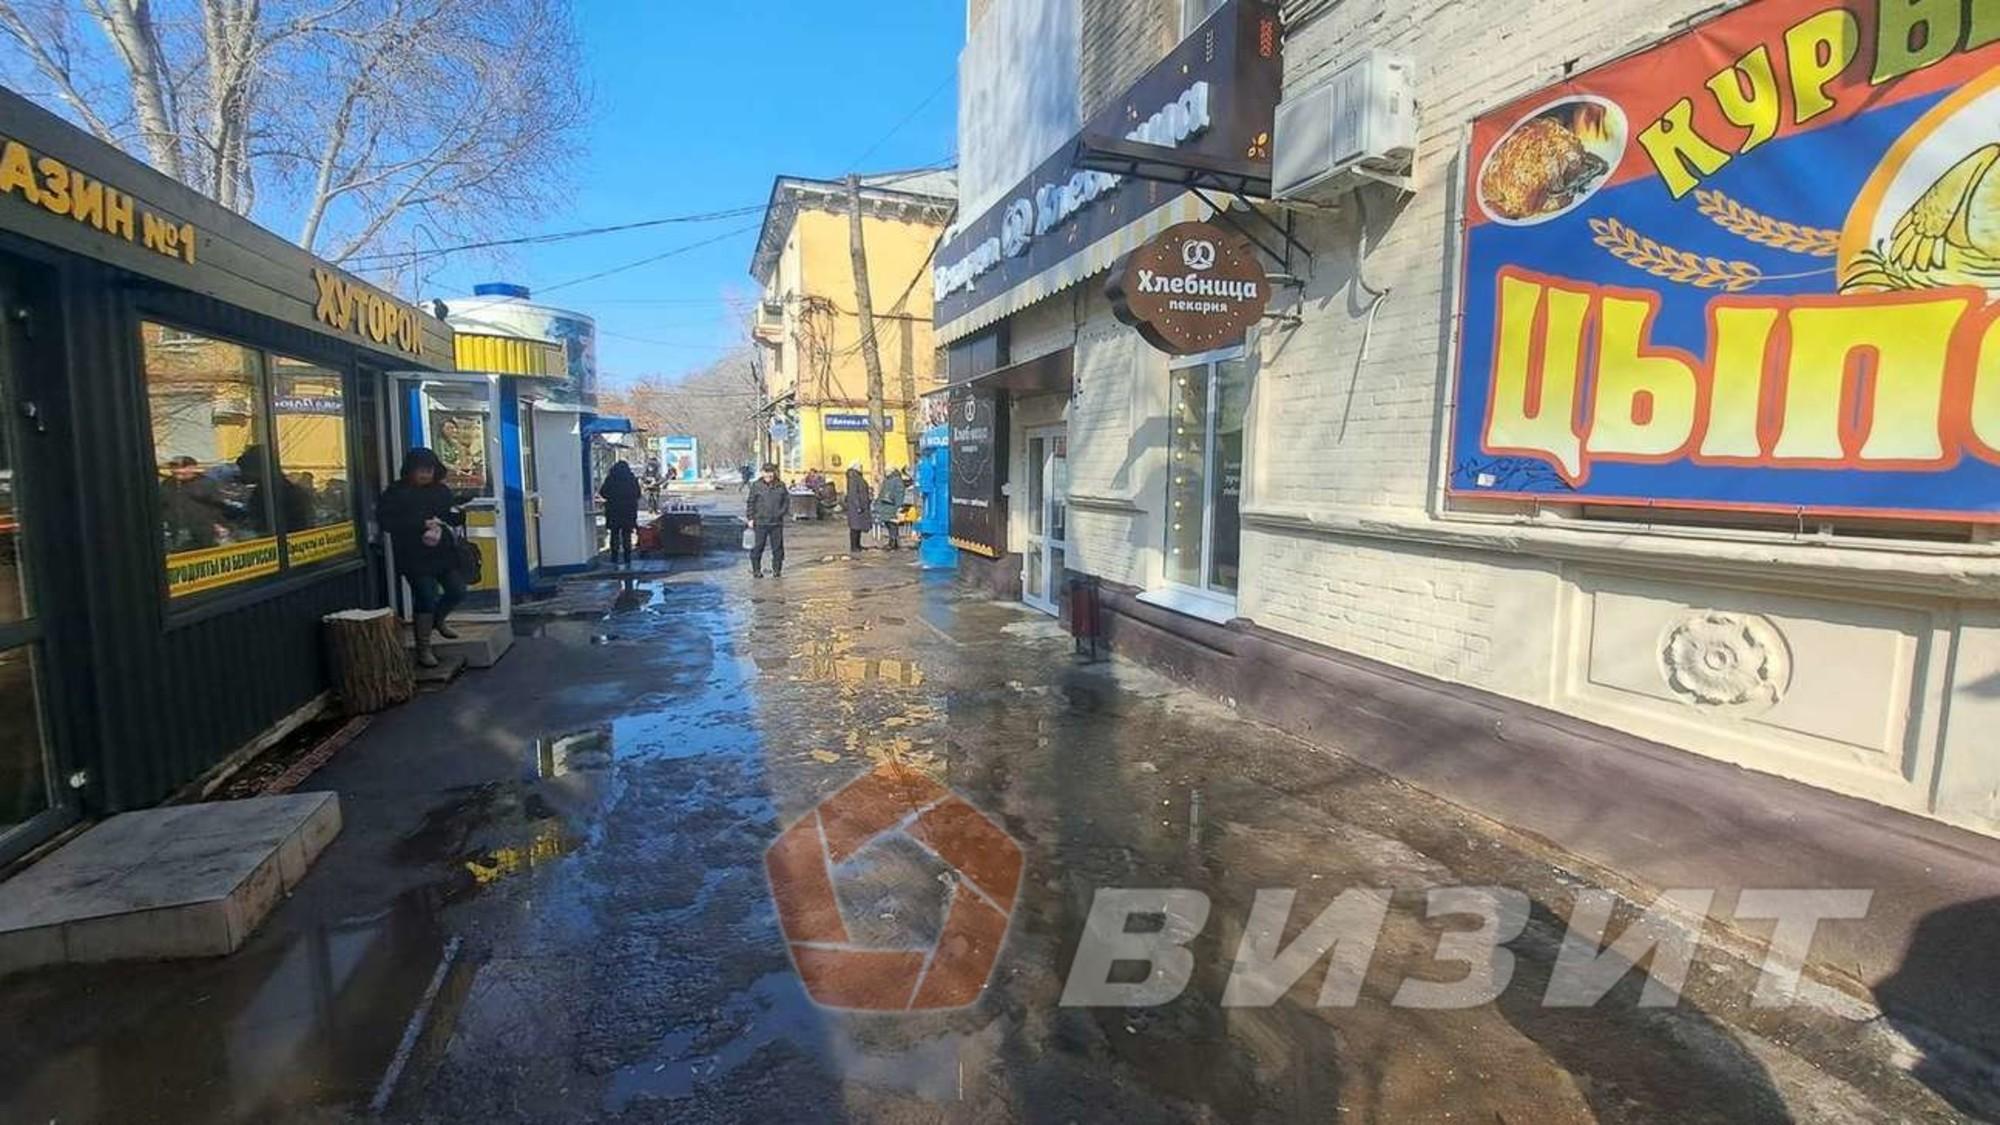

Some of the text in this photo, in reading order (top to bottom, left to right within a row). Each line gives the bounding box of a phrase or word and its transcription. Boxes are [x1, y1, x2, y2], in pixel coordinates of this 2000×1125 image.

[143, 211, 195, 265] №1
[1137, 269, 1257, 302] Хлебница
[1169, 299, 1228, 315] пекарня
